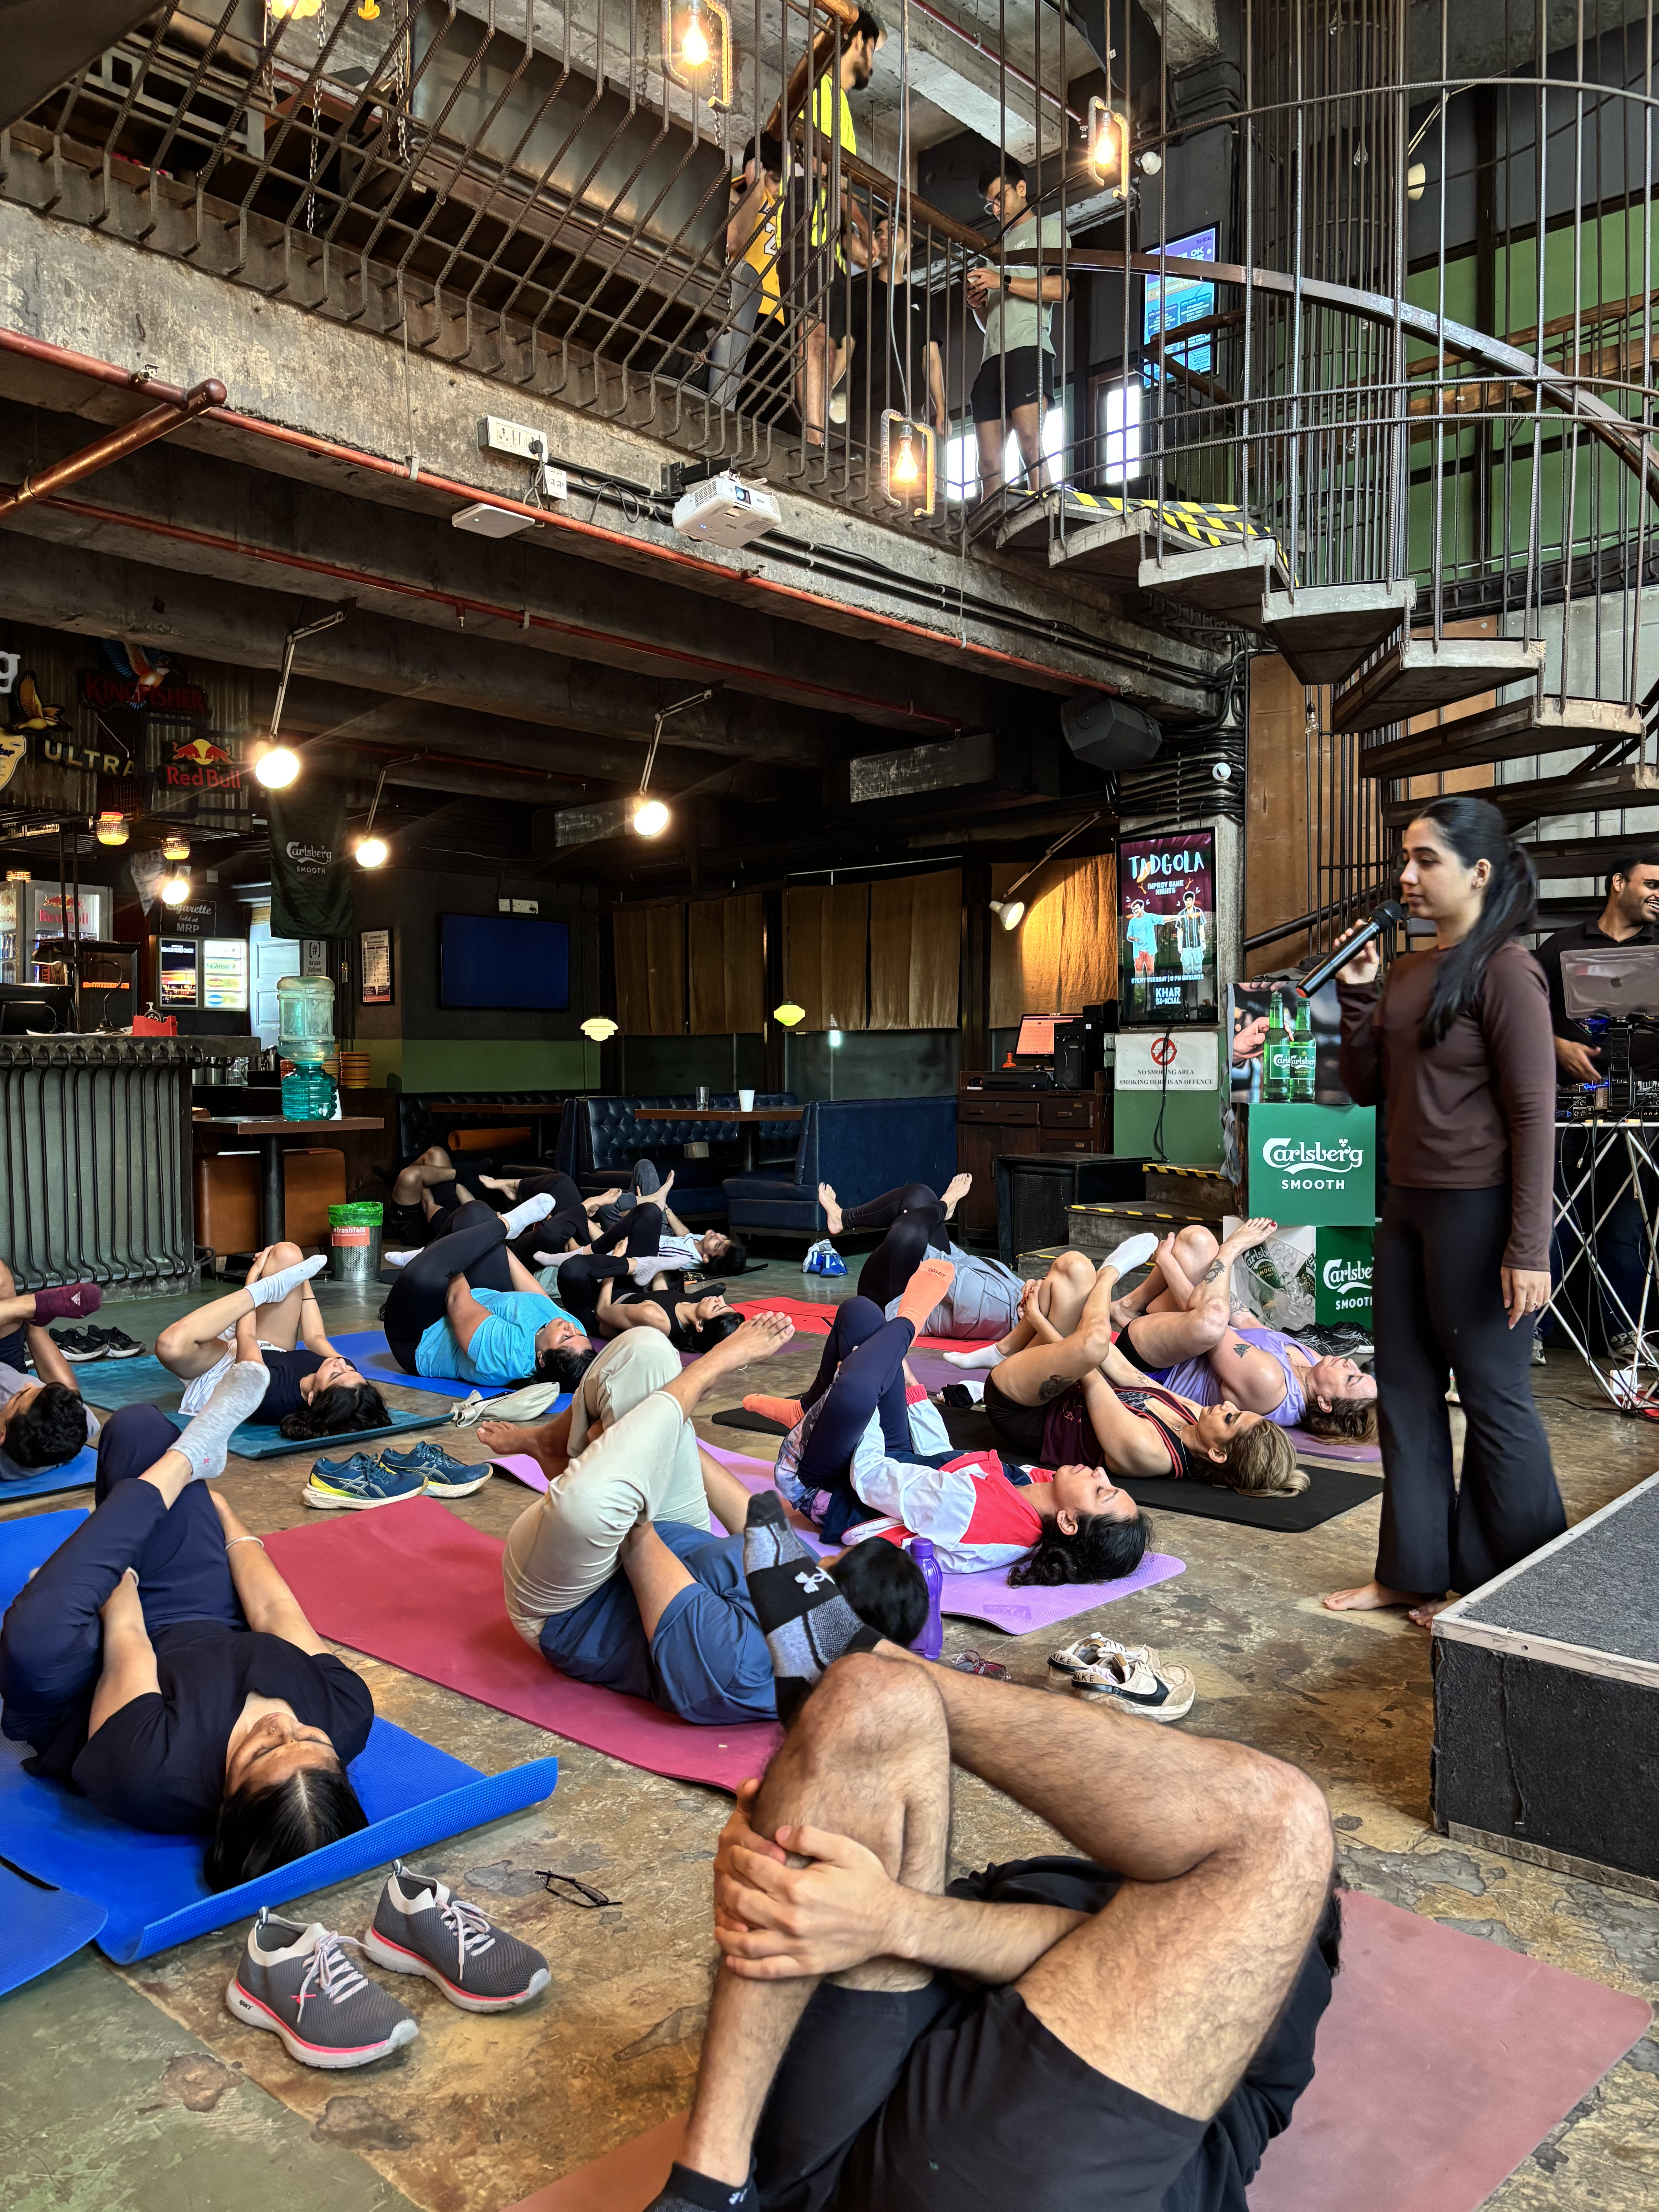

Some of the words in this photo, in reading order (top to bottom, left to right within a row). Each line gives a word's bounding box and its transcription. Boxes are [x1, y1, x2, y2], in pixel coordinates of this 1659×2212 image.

[86, 673, 205, 714] KINGFISHER
[45, 740, 134, 776] ULTRA
[167, 766, 203, 787] Red
[206, 769, 241, 788] Bull
[286, 842, 331, 864] Carlsberg
[296, 866, 325, 874] SMOOTH
[1128, 850, 1204, 879] TADGOLA
[1147, 881, 1168, 890] IMPROV
[1169, 879, 1184, 888] GAME
[1155, 887, 1176, 895] NIGHTS
[177, 923, 199, 933] MRP
[1155, 987, 1181, 998] KHAR
[1273, 1054, 1290, 1066] Carls
[1263, 1138, 1364, 1171] Carlsberg
[1281, 1180, 1345, 1190] SMOOTH
[1323, 1259, 1373, 1290] Carlsbe
[1052, 1653, 1072, 1664] NIKE
[1073, 1671, 1094, 1682] NIKE
